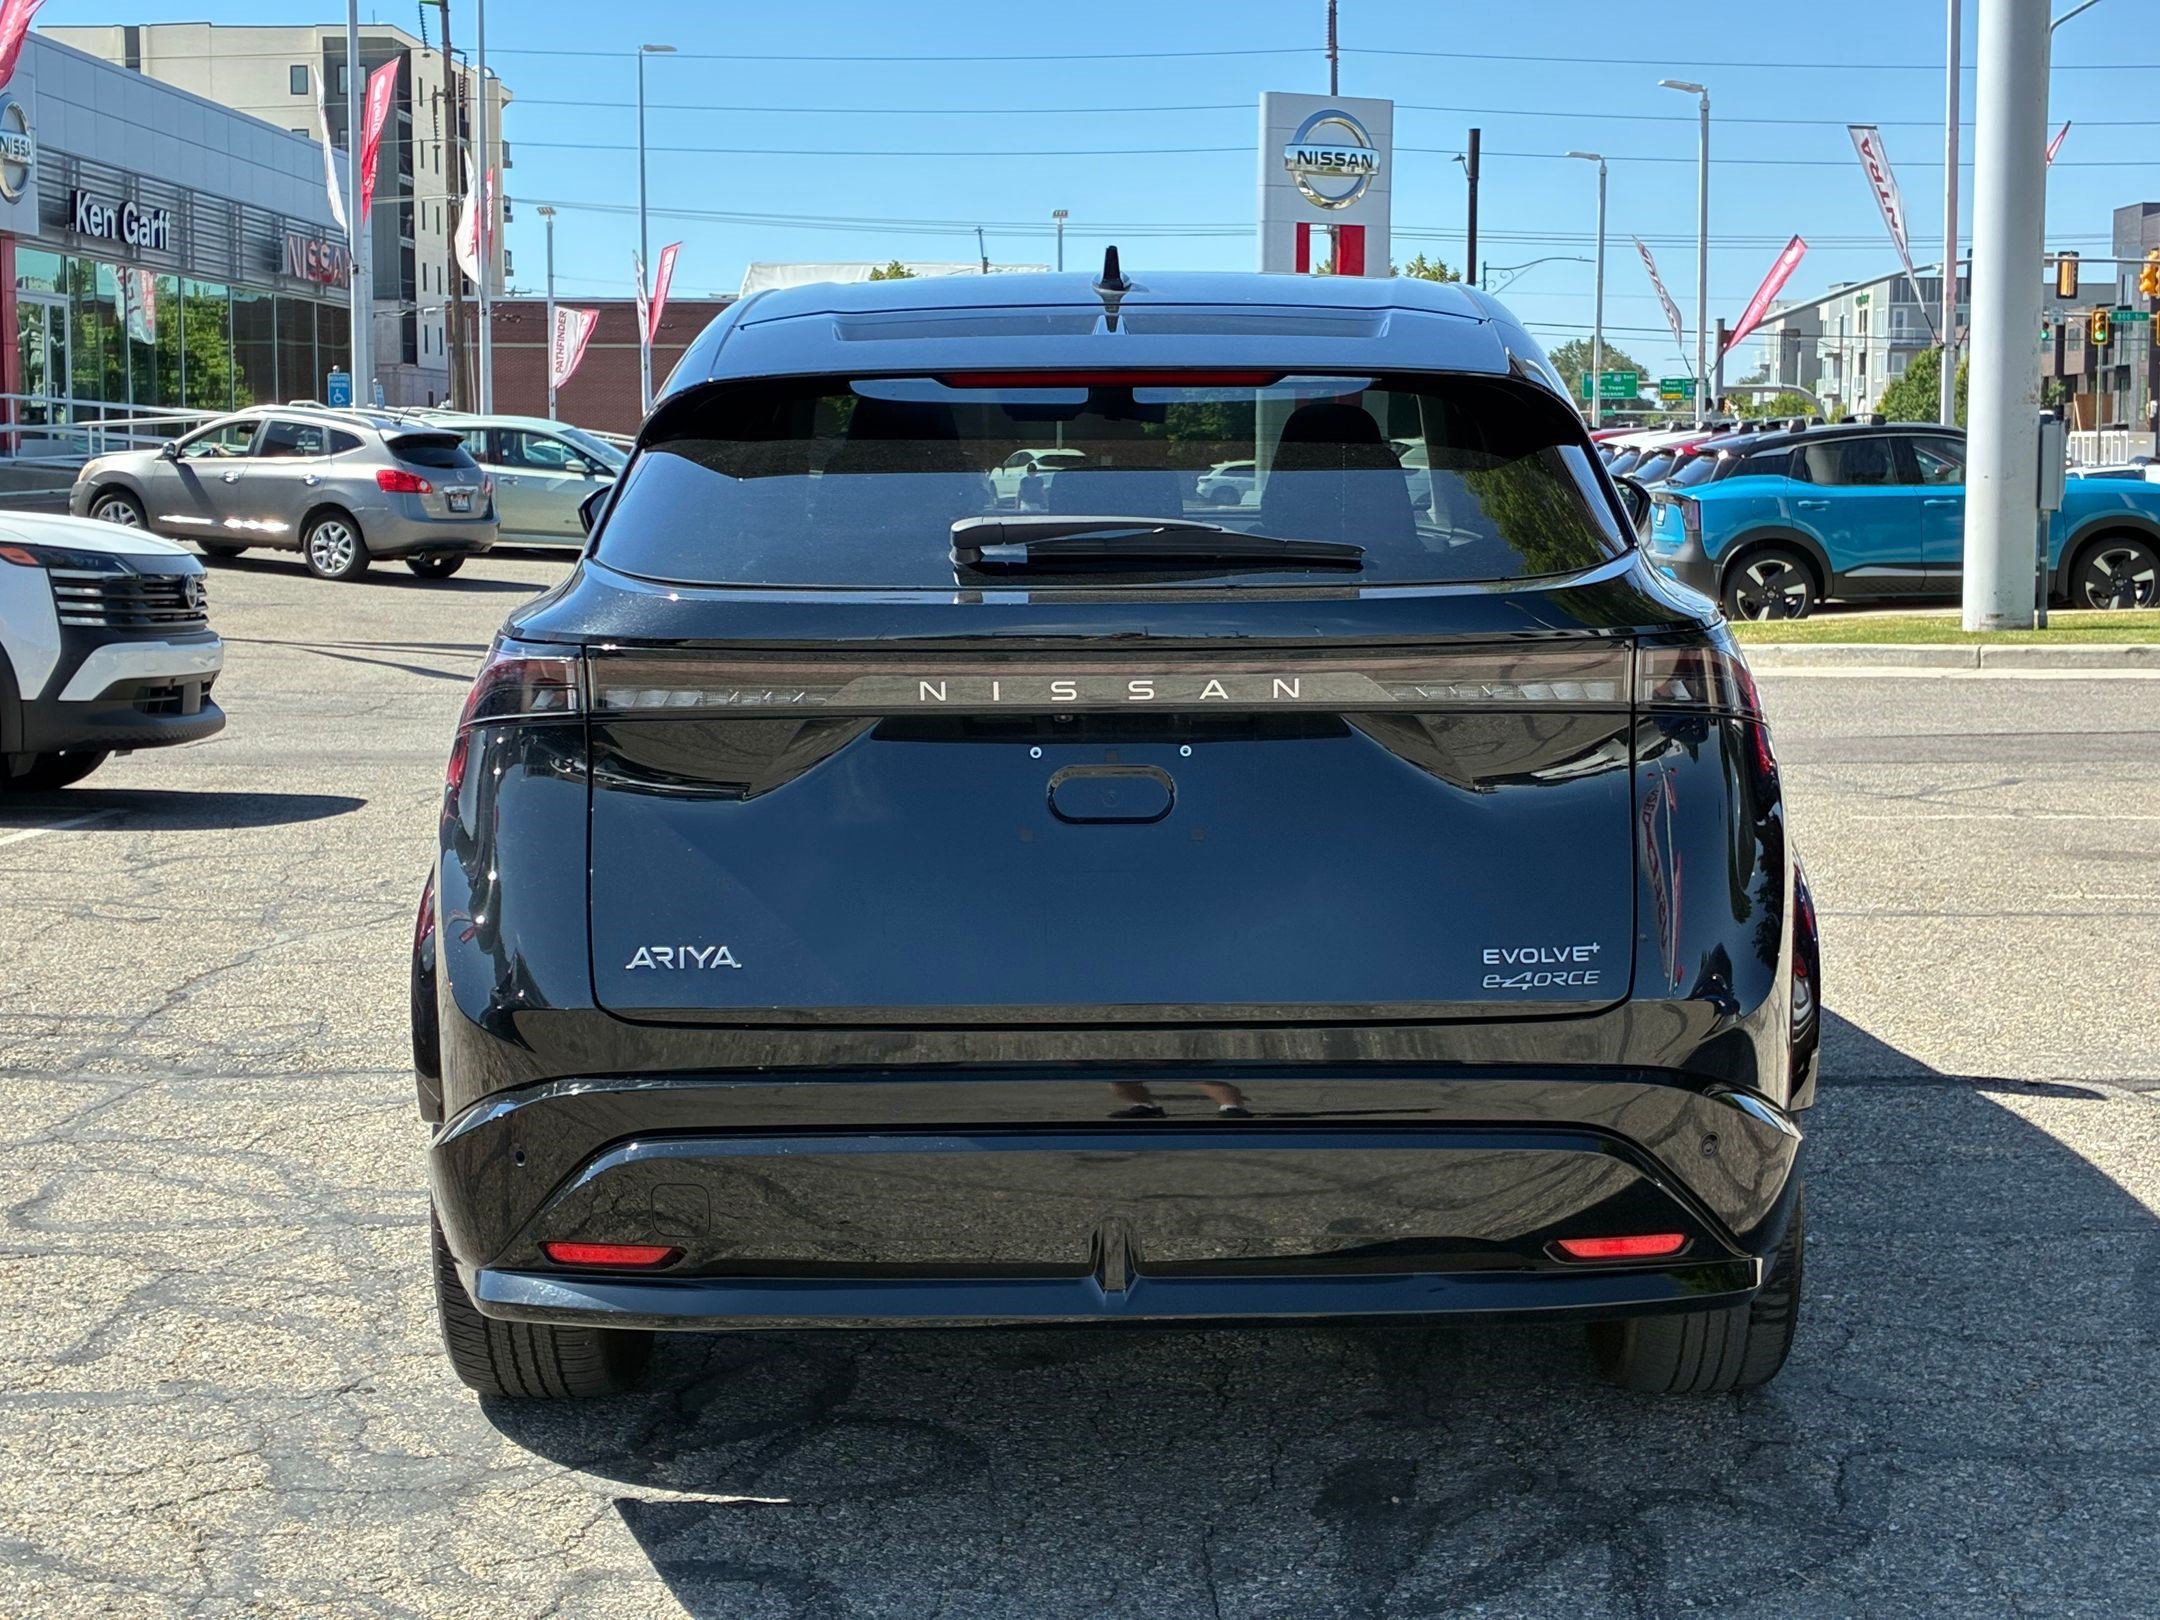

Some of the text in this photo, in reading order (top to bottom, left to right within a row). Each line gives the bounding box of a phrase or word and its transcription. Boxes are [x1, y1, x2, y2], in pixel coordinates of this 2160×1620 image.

[1297, 150, 1374, 169] NISSAN
[75, 189, 171, 250] Ken Garff
[555, 310, 568, 374] PATHFINDER
[919, 678, 1301, 702] NISSAN
[625, 945, 743, 970] ARIYA
[1482, 941, 1601, 965] EVOLVE+
